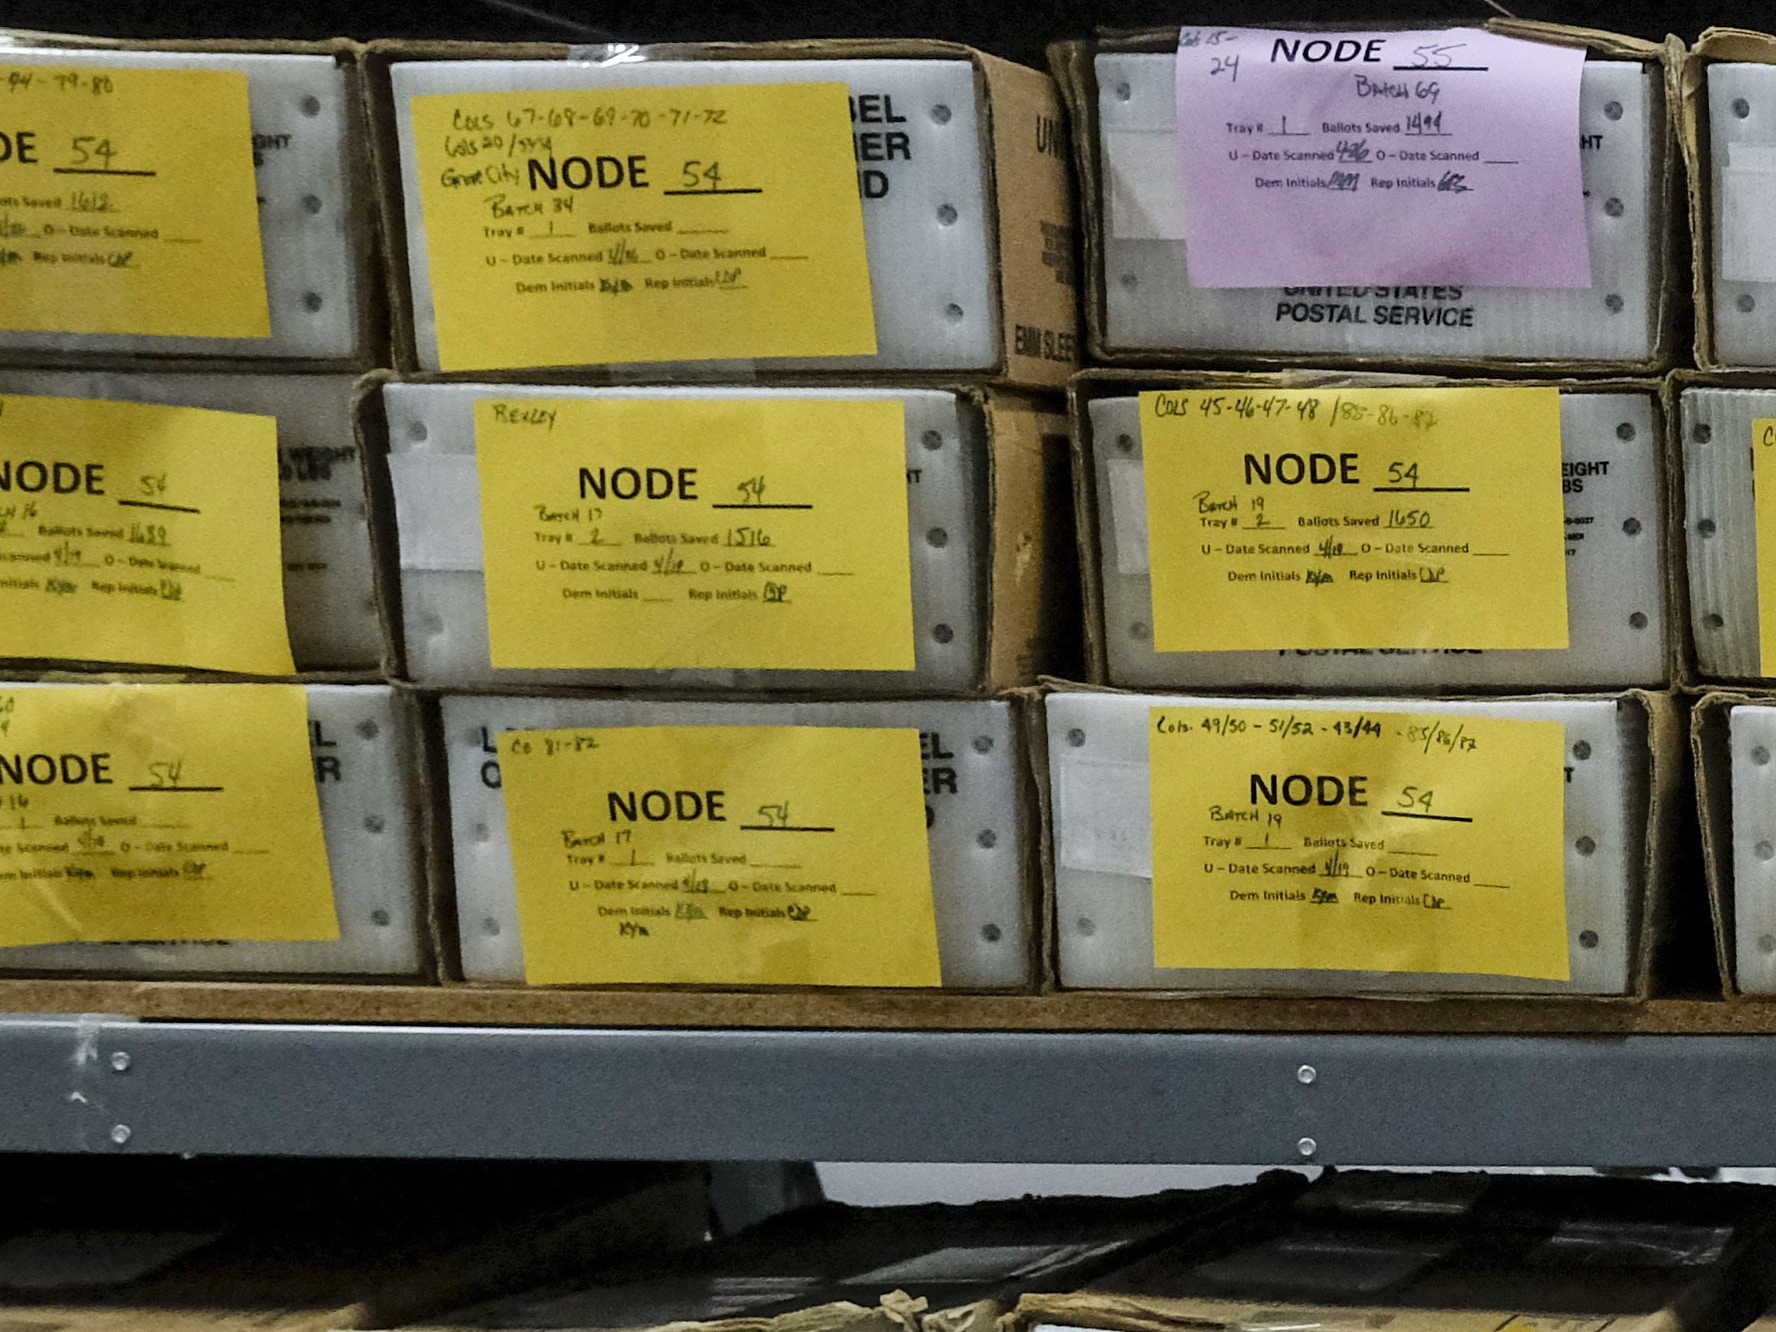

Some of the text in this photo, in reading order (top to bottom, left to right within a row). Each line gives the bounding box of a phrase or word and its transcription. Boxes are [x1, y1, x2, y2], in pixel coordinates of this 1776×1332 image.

[528, 156, 724, 190] NODE 54
[1276, 302, 1474, 327] POSTAL SERVICE
[580, 468, 765, 503] NODE 54
[1245, 454, 1419, 488] NODE 54
[1298, 516, 1340, 527] Ballots
[1344, 516, 1379, 527] Saved
[608, 791, 726, 821] NODE
[1251, 774, 1433, 812] NODE 54
